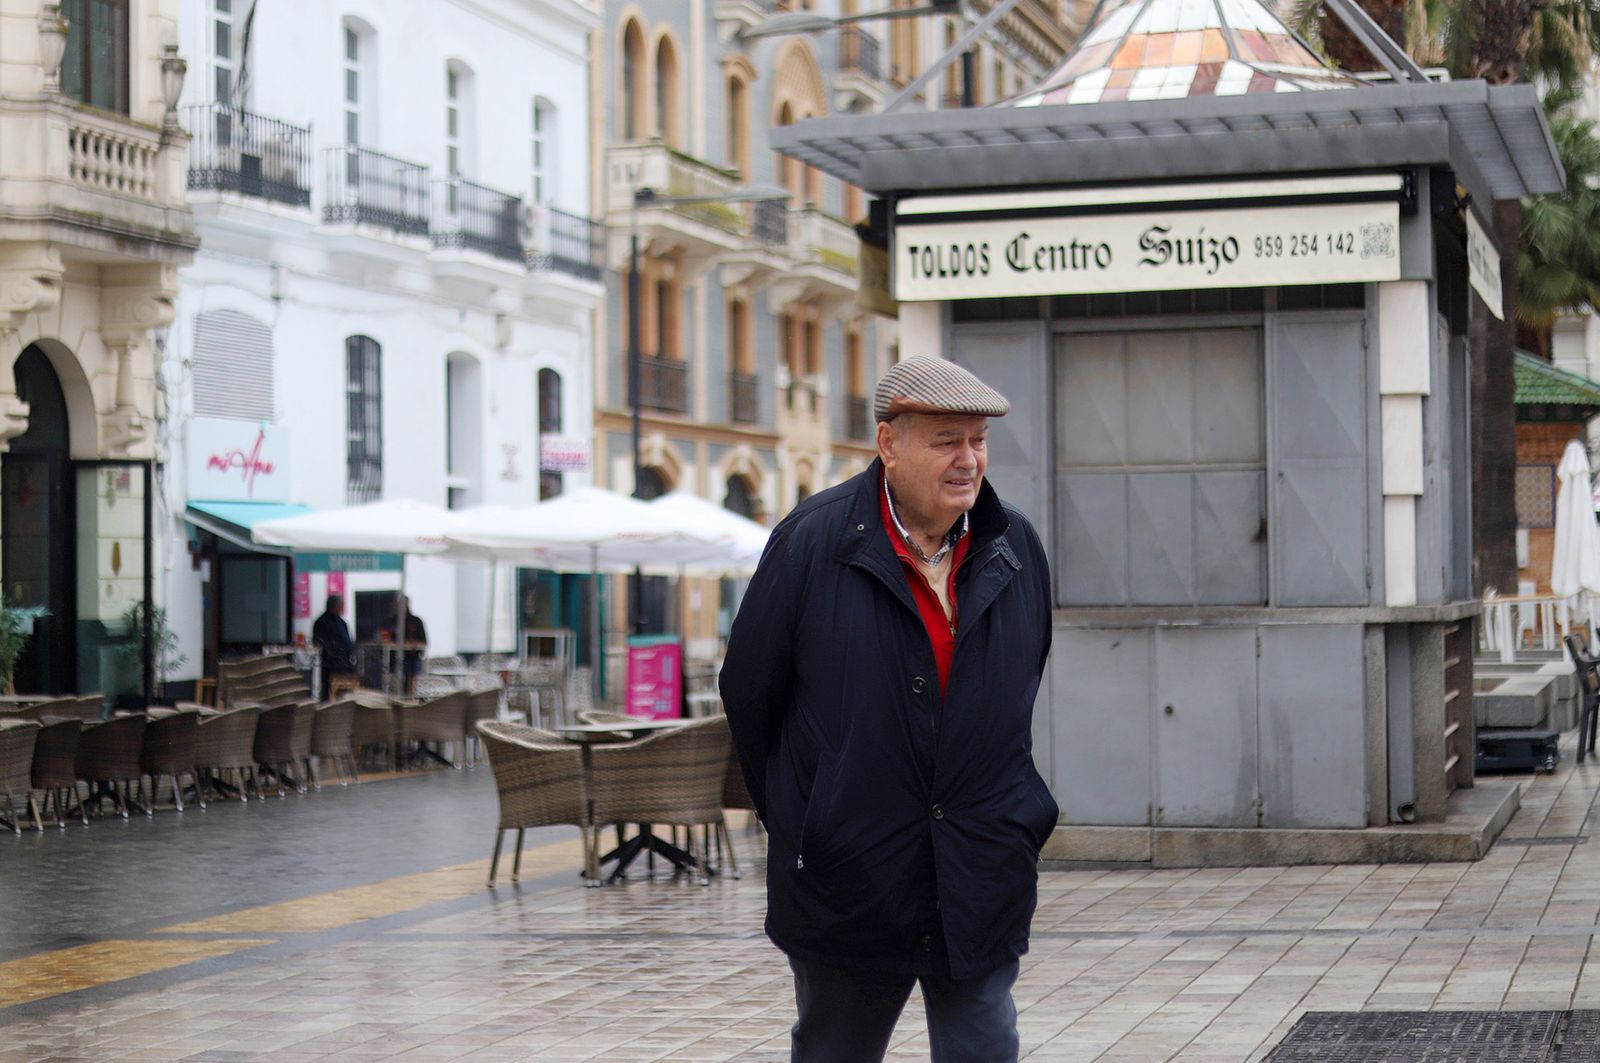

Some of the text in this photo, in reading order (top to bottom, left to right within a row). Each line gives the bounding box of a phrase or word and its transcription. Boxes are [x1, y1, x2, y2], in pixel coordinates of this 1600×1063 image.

[908, 224, 1354, 279] TOLDOS Centro Suizo 959 254 142
